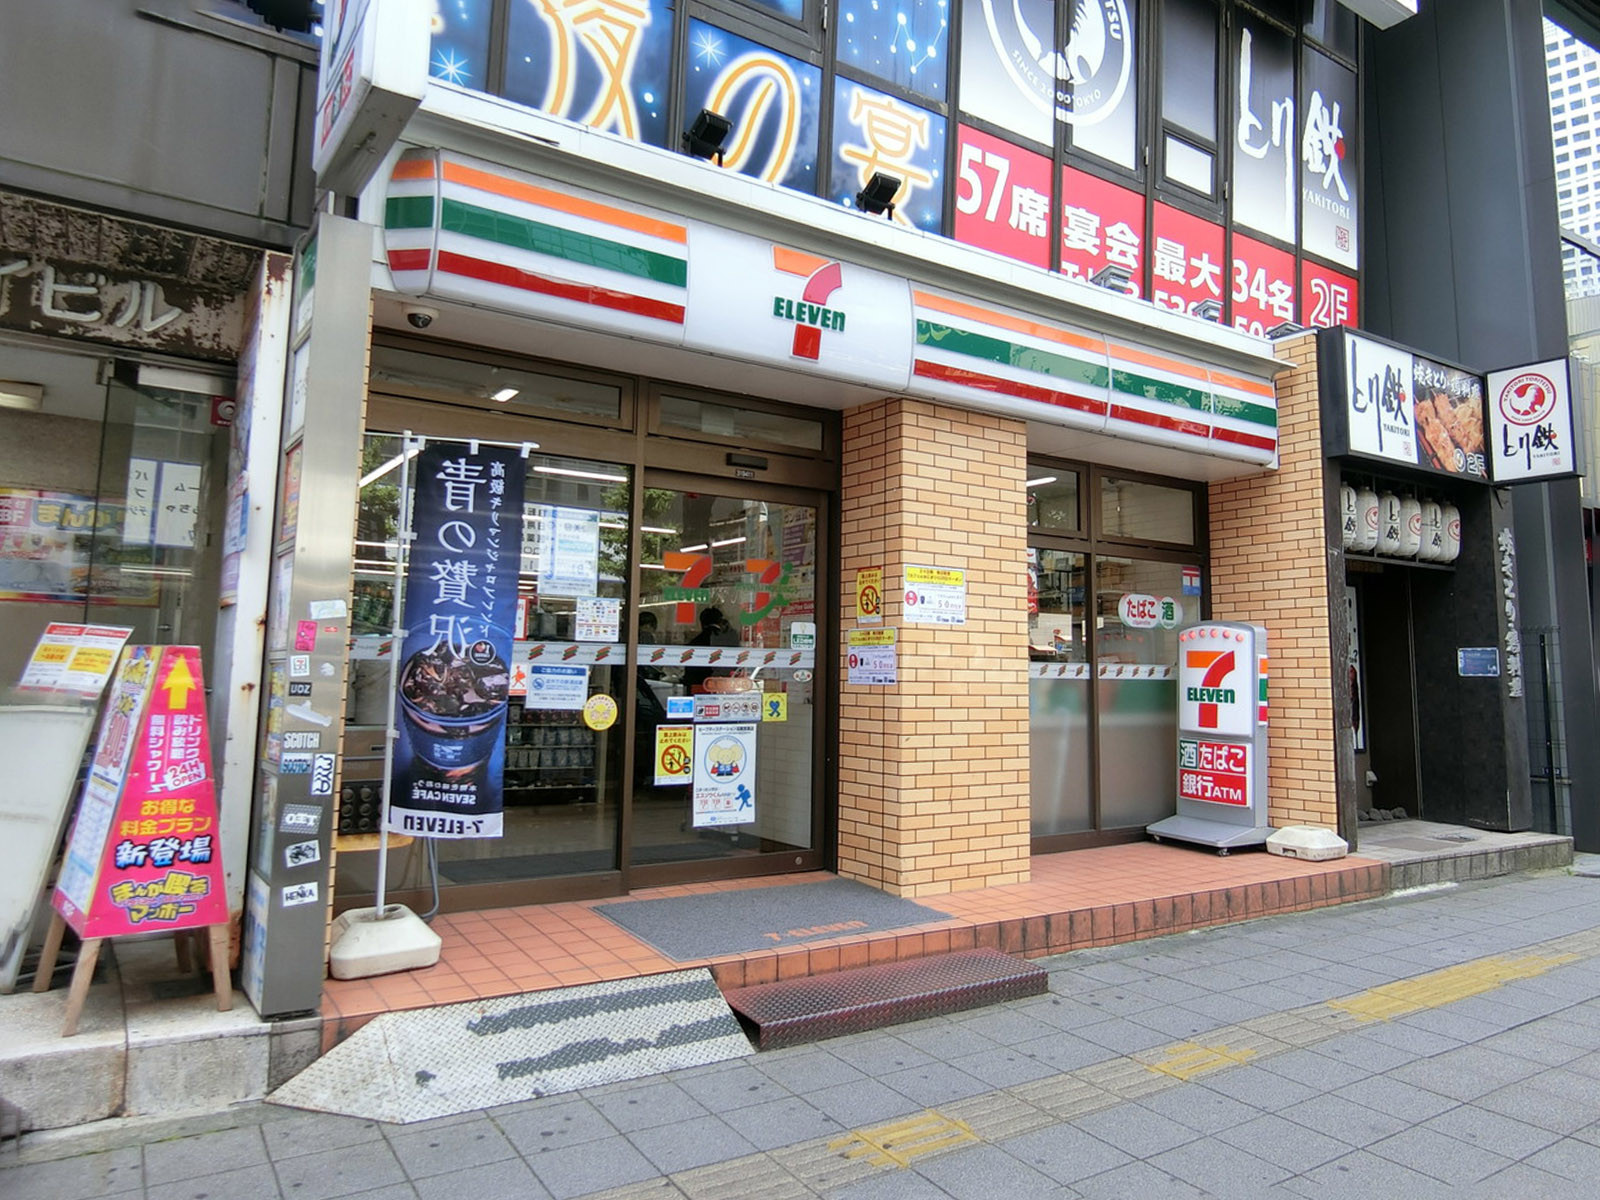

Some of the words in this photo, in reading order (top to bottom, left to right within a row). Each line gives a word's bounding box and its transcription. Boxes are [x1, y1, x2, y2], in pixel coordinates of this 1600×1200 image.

[956, 143, 1049, 238] 57席
[1063, 204, 1141, 268] 宴会
[1154, 236, 1221, 297] 最大
[1232, 258, 1294, 321] 34名
[0, 258, 182, 332] ビル
[1309, 278, 1349, 328] 2F
[1126, 600, 1157, 620] たばこ
[283, 731, 321, 750] SCOTCH
[168, 759, 200, 779] 24H
[1180, 742, 1198, 767] 酒
[1199, 744, 1245, 772] たばこ
[172, 772, 203, 788] OPEN
[1182, 772, 1242, 801] 銀行ATM
[140, 798, 197, 816] お得な
[119, 816, 213, 837] 料金プラン
[115, 836, 212, 868] 新登場
